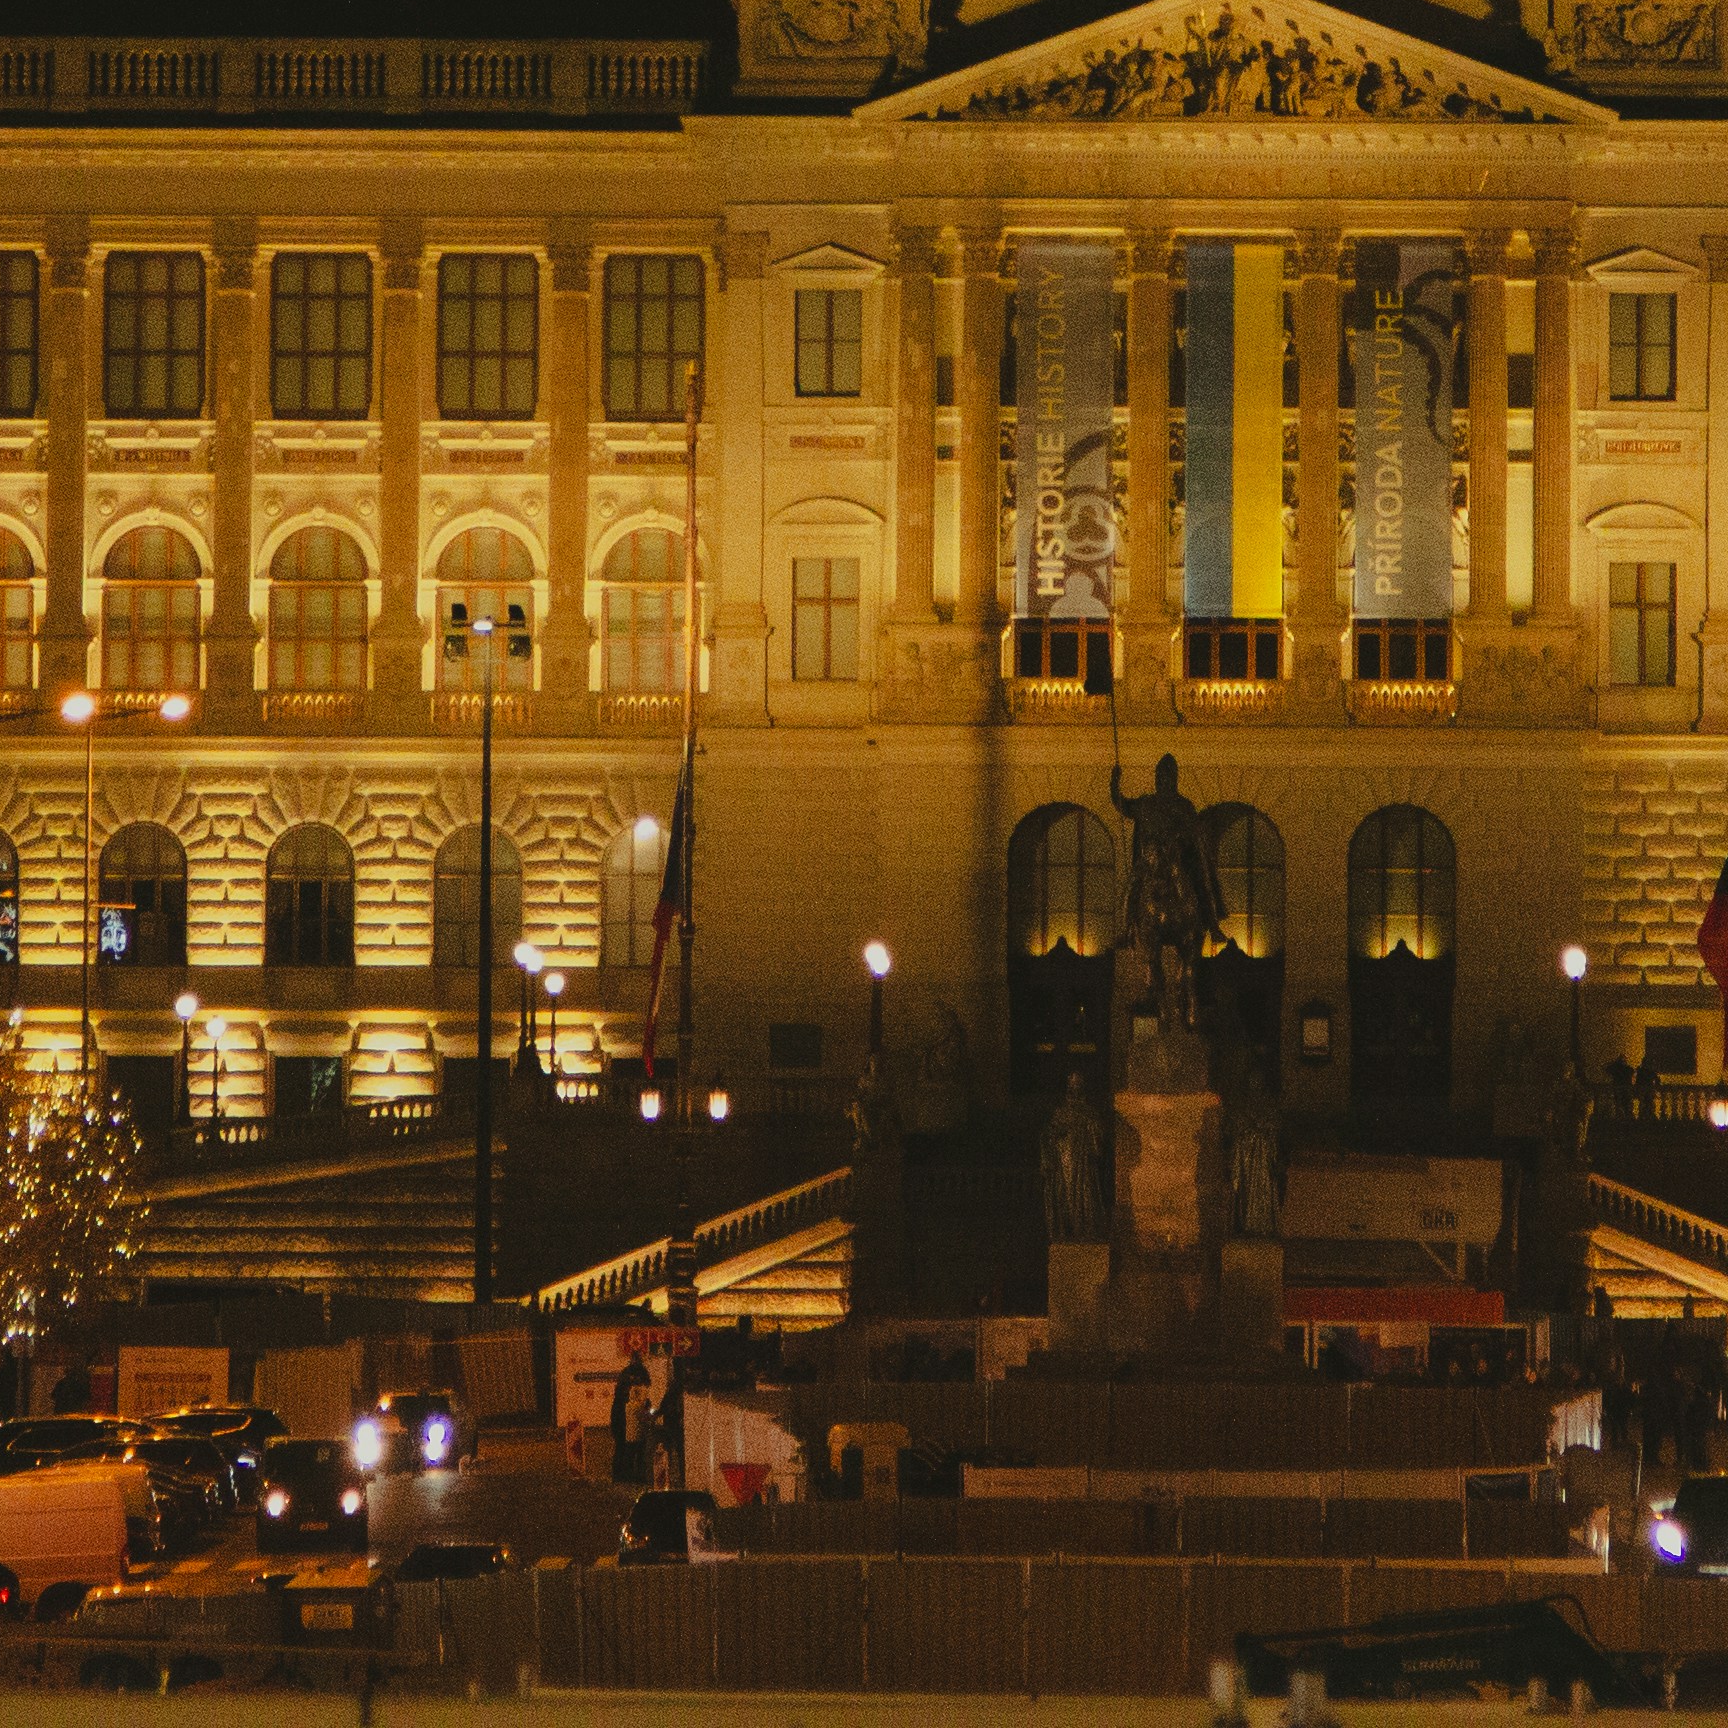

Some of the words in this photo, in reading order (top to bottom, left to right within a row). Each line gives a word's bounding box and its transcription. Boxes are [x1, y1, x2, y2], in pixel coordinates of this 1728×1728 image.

[1036, 269, 1065, 421] HISTORY
[1375, 289, 1404, 432] NATURE
[1036, 431, 1065, 596] HISTORIE
[1369, 439, 1404, 596] PŘÍRODA
